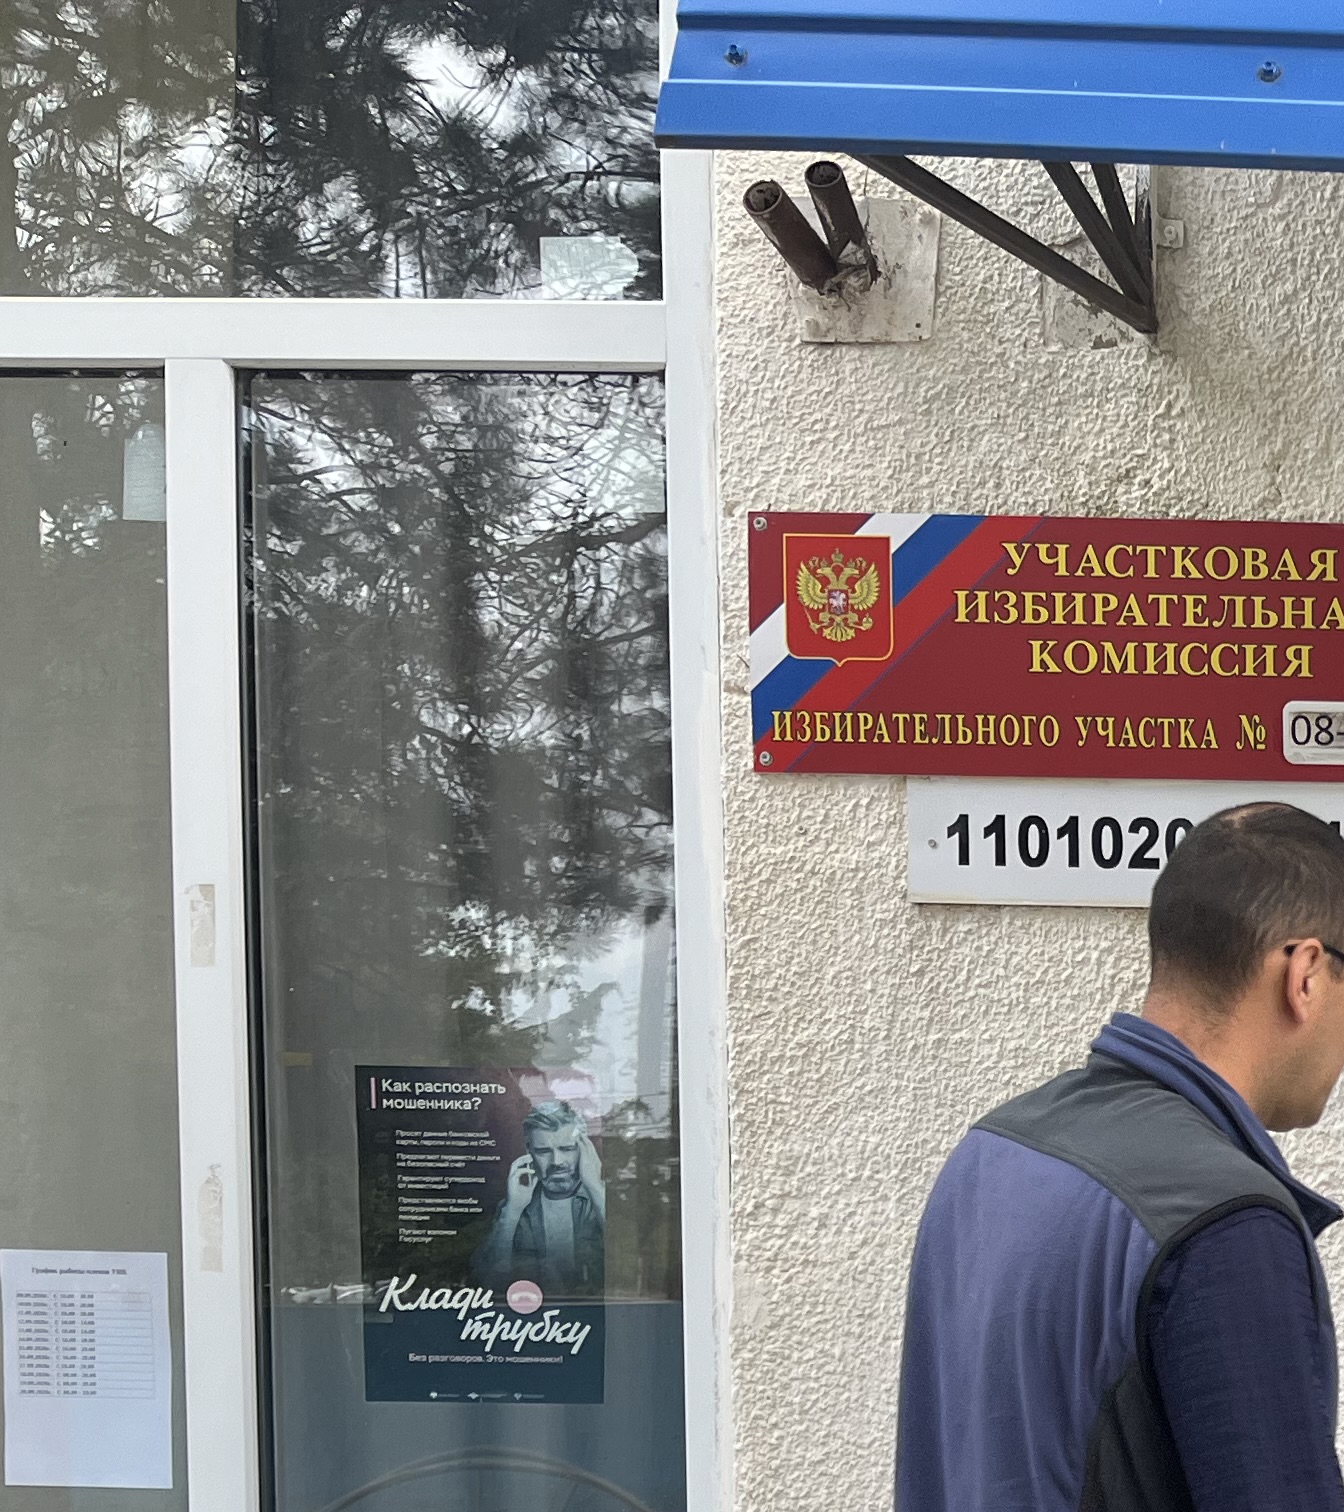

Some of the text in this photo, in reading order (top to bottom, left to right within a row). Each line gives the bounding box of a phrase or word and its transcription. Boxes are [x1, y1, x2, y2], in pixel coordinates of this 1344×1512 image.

[1003, 542, 1339, 582] УЧАСТКОВАЯ
[1029, 639, 1314, 678] КОМИССИЯ
[772, 709, 1060, 748] ИЗБИРАТЕЛЬНОГО
[1076, 715, 1219, 750] УЧАСТКА
[1235, 713, 1267, 751] №
[381, 1078, 507, 1096] Как распознать
[382, 1096, 483, 1111] мошенника?
[378, 1273, 495, 1321] Клади
[459, 1309, 592, 1354] трубку
